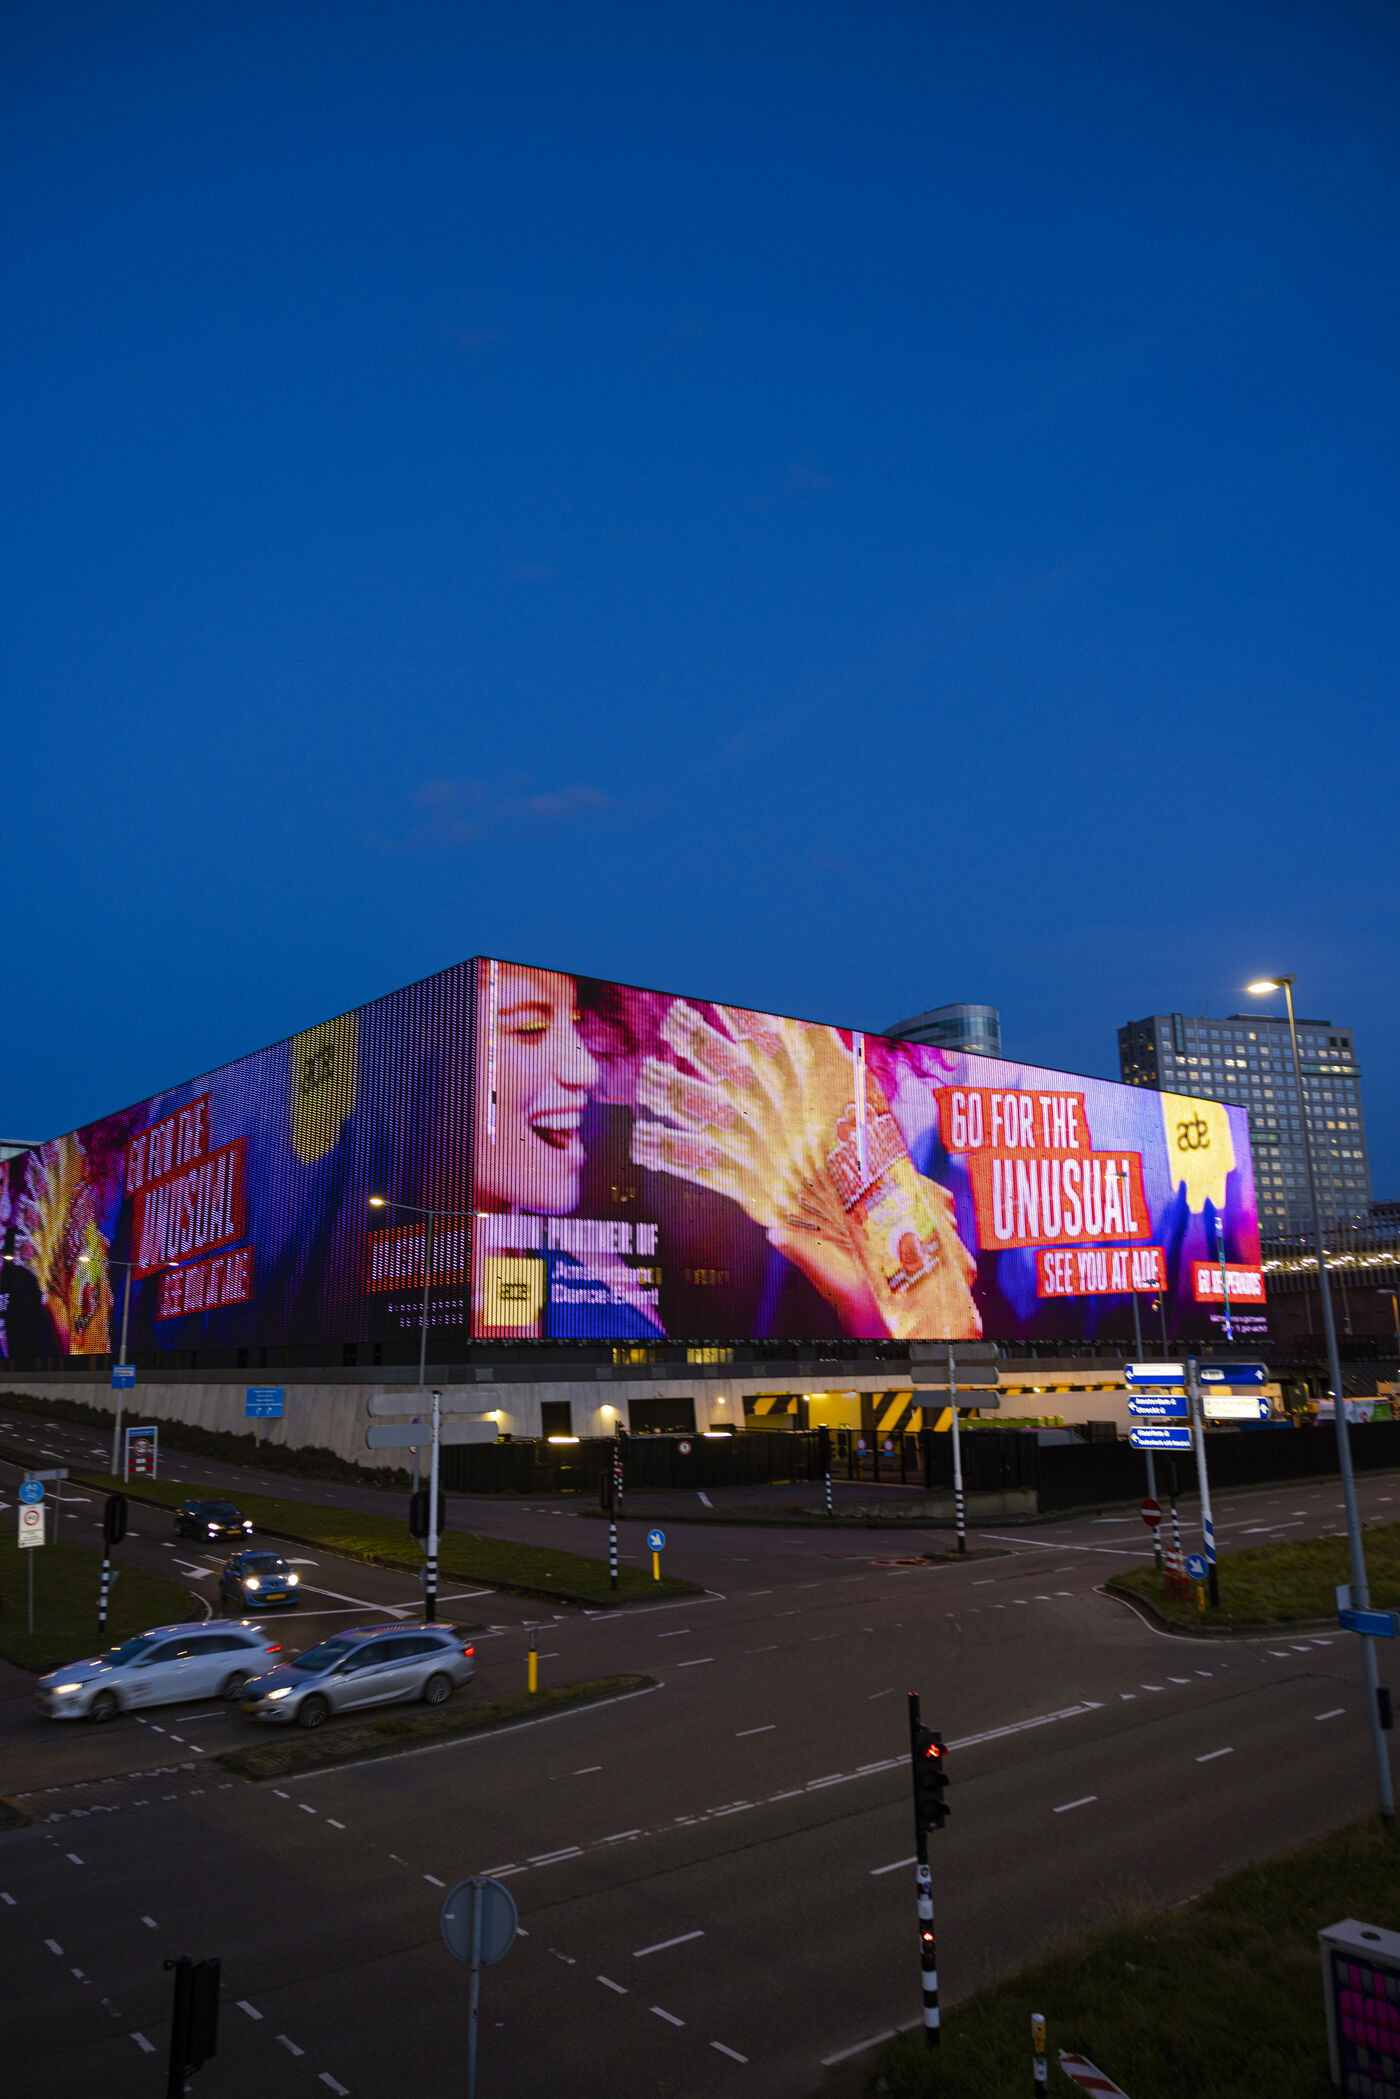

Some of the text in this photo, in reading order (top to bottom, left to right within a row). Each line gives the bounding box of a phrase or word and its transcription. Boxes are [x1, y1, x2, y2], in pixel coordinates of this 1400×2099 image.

[951, 1091, 1080, 1149] GO FOR THE
[992, 1158, 1139, 1240] UNUSUAL
[1043, 1250, 1161, 1293] SEE YOU AT ADE
